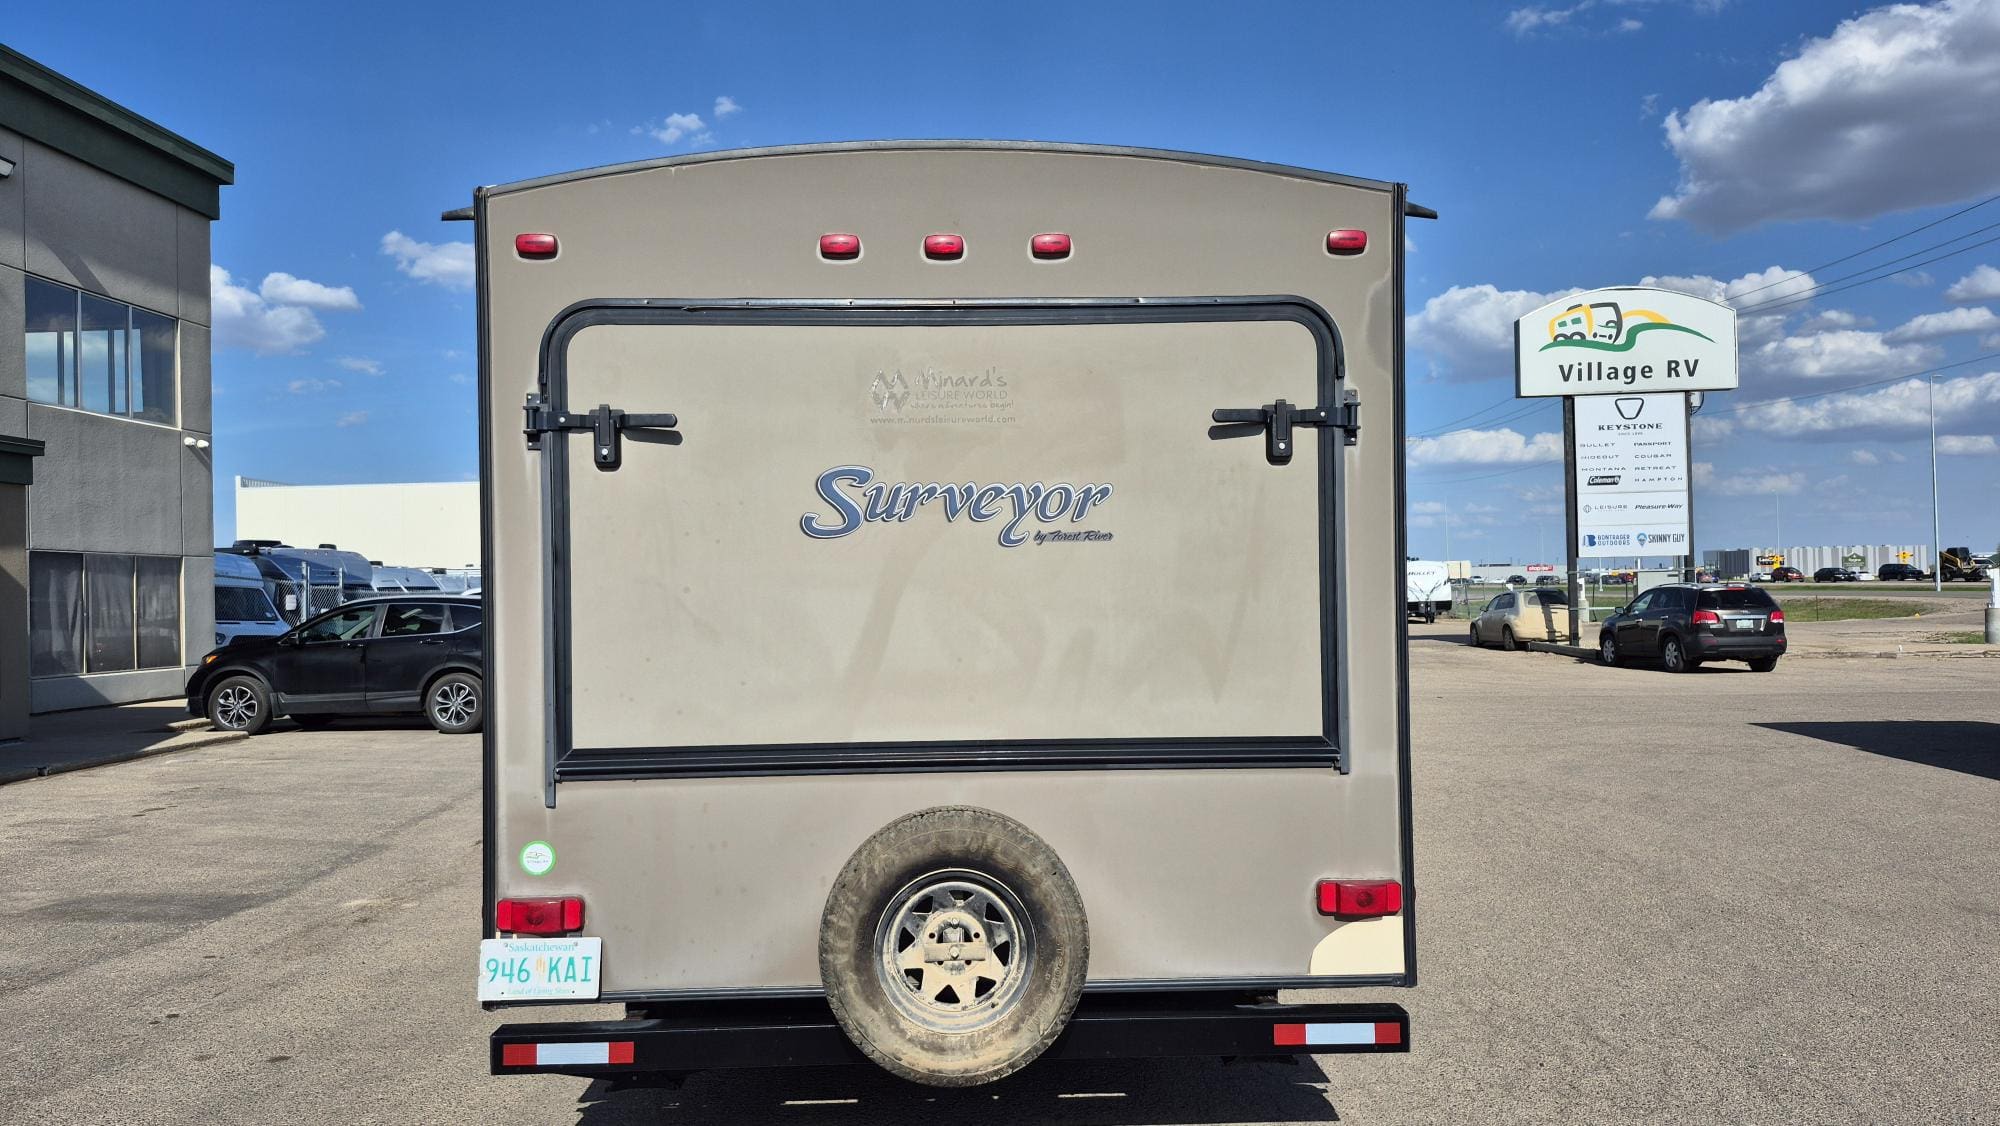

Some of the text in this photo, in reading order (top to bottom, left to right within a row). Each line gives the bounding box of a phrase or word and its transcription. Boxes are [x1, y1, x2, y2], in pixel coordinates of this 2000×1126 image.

[914, 366, 1007, 390] Minard's
[1558, 359, 1699, 384] Village RV
[1598, 423, 1663, 431] KEYSTONE
[800, 465, 1114, 548] Surveyor
[1033, 530, 1114, 546] by Forest River
[1648, 533, 1686, 544] SKINNY GUY
[508, 942, 576, 952] Saskatchewan
[485, 956, 593, 984] 946 KAI
